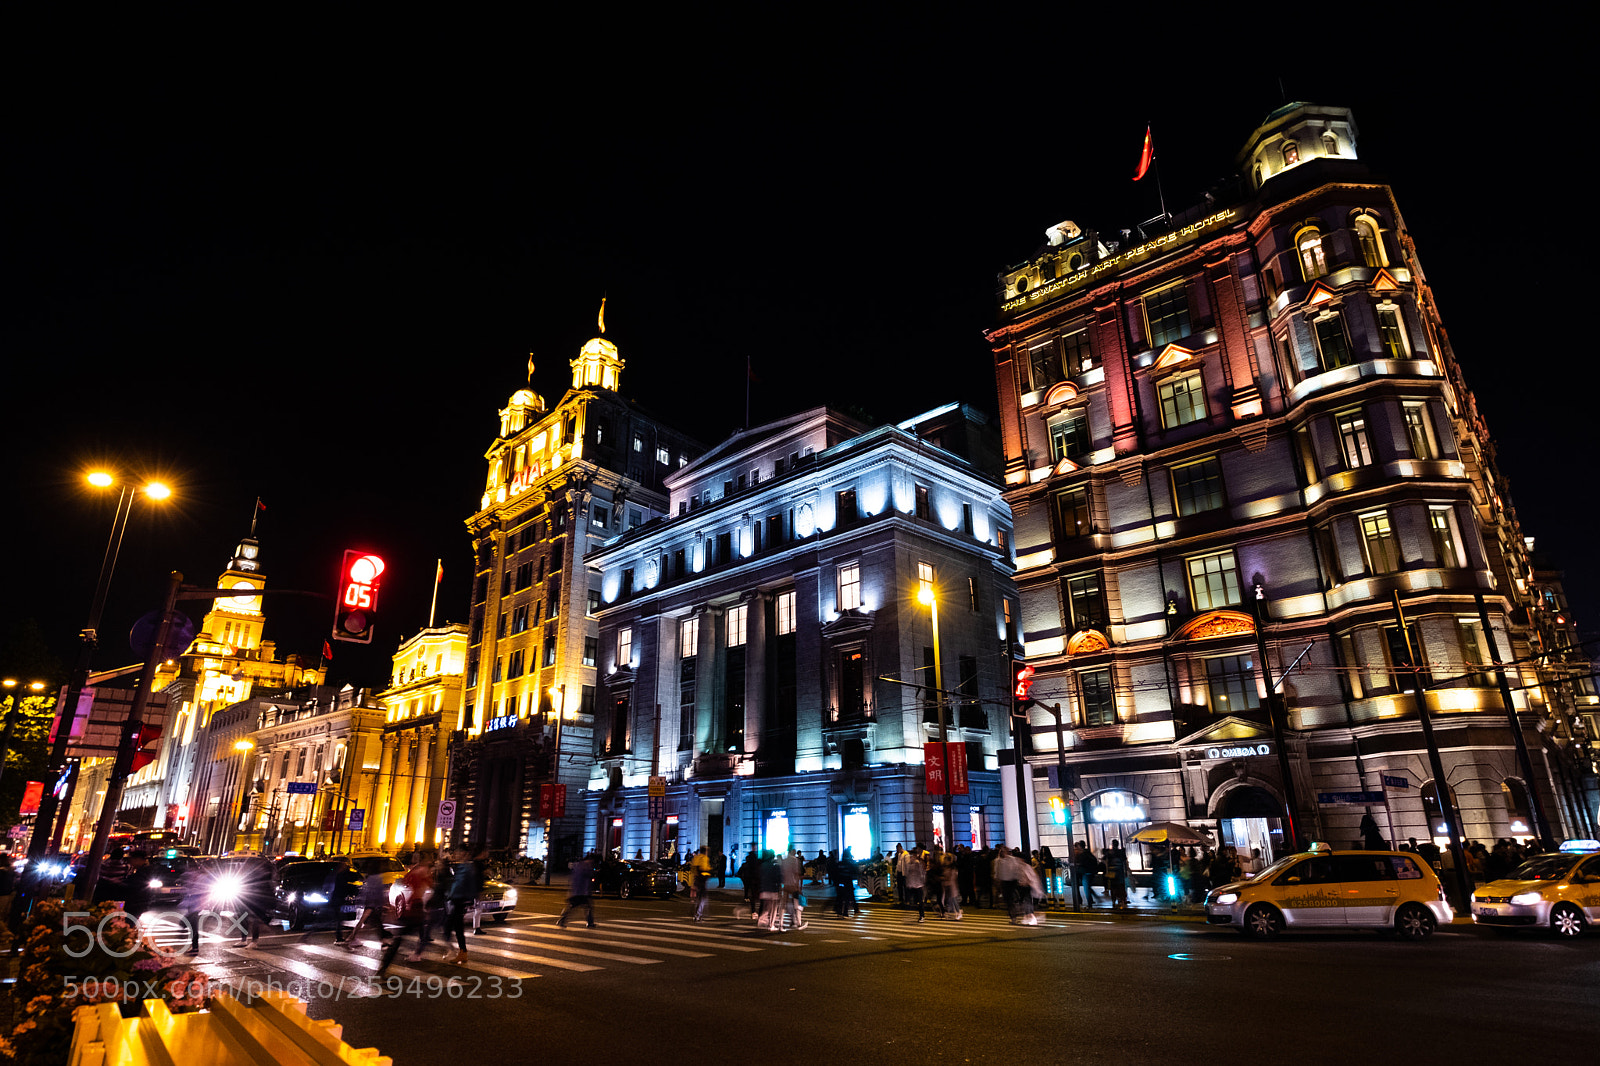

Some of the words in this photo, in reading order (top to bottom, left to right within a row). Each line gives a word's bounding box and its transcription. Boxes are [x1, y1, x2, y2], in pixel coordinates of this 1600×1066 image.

[1001, 296, 1026, 311] THE
[1030, 269, 1087, 300] SWATCH
[1091, 257, 1120, 275] ART
[1125, 231, 1177, 260] PEACE
[1181, 208, 1236, 236] HOTEL
[510, 459, 541, 495] AIA
[345, 583, 371, 607] 05
[1221, 747, 1257, 758] OMEGA
[928, 755, 942, 781] 文明
[1291, 900, 1338, 908] 62580000
